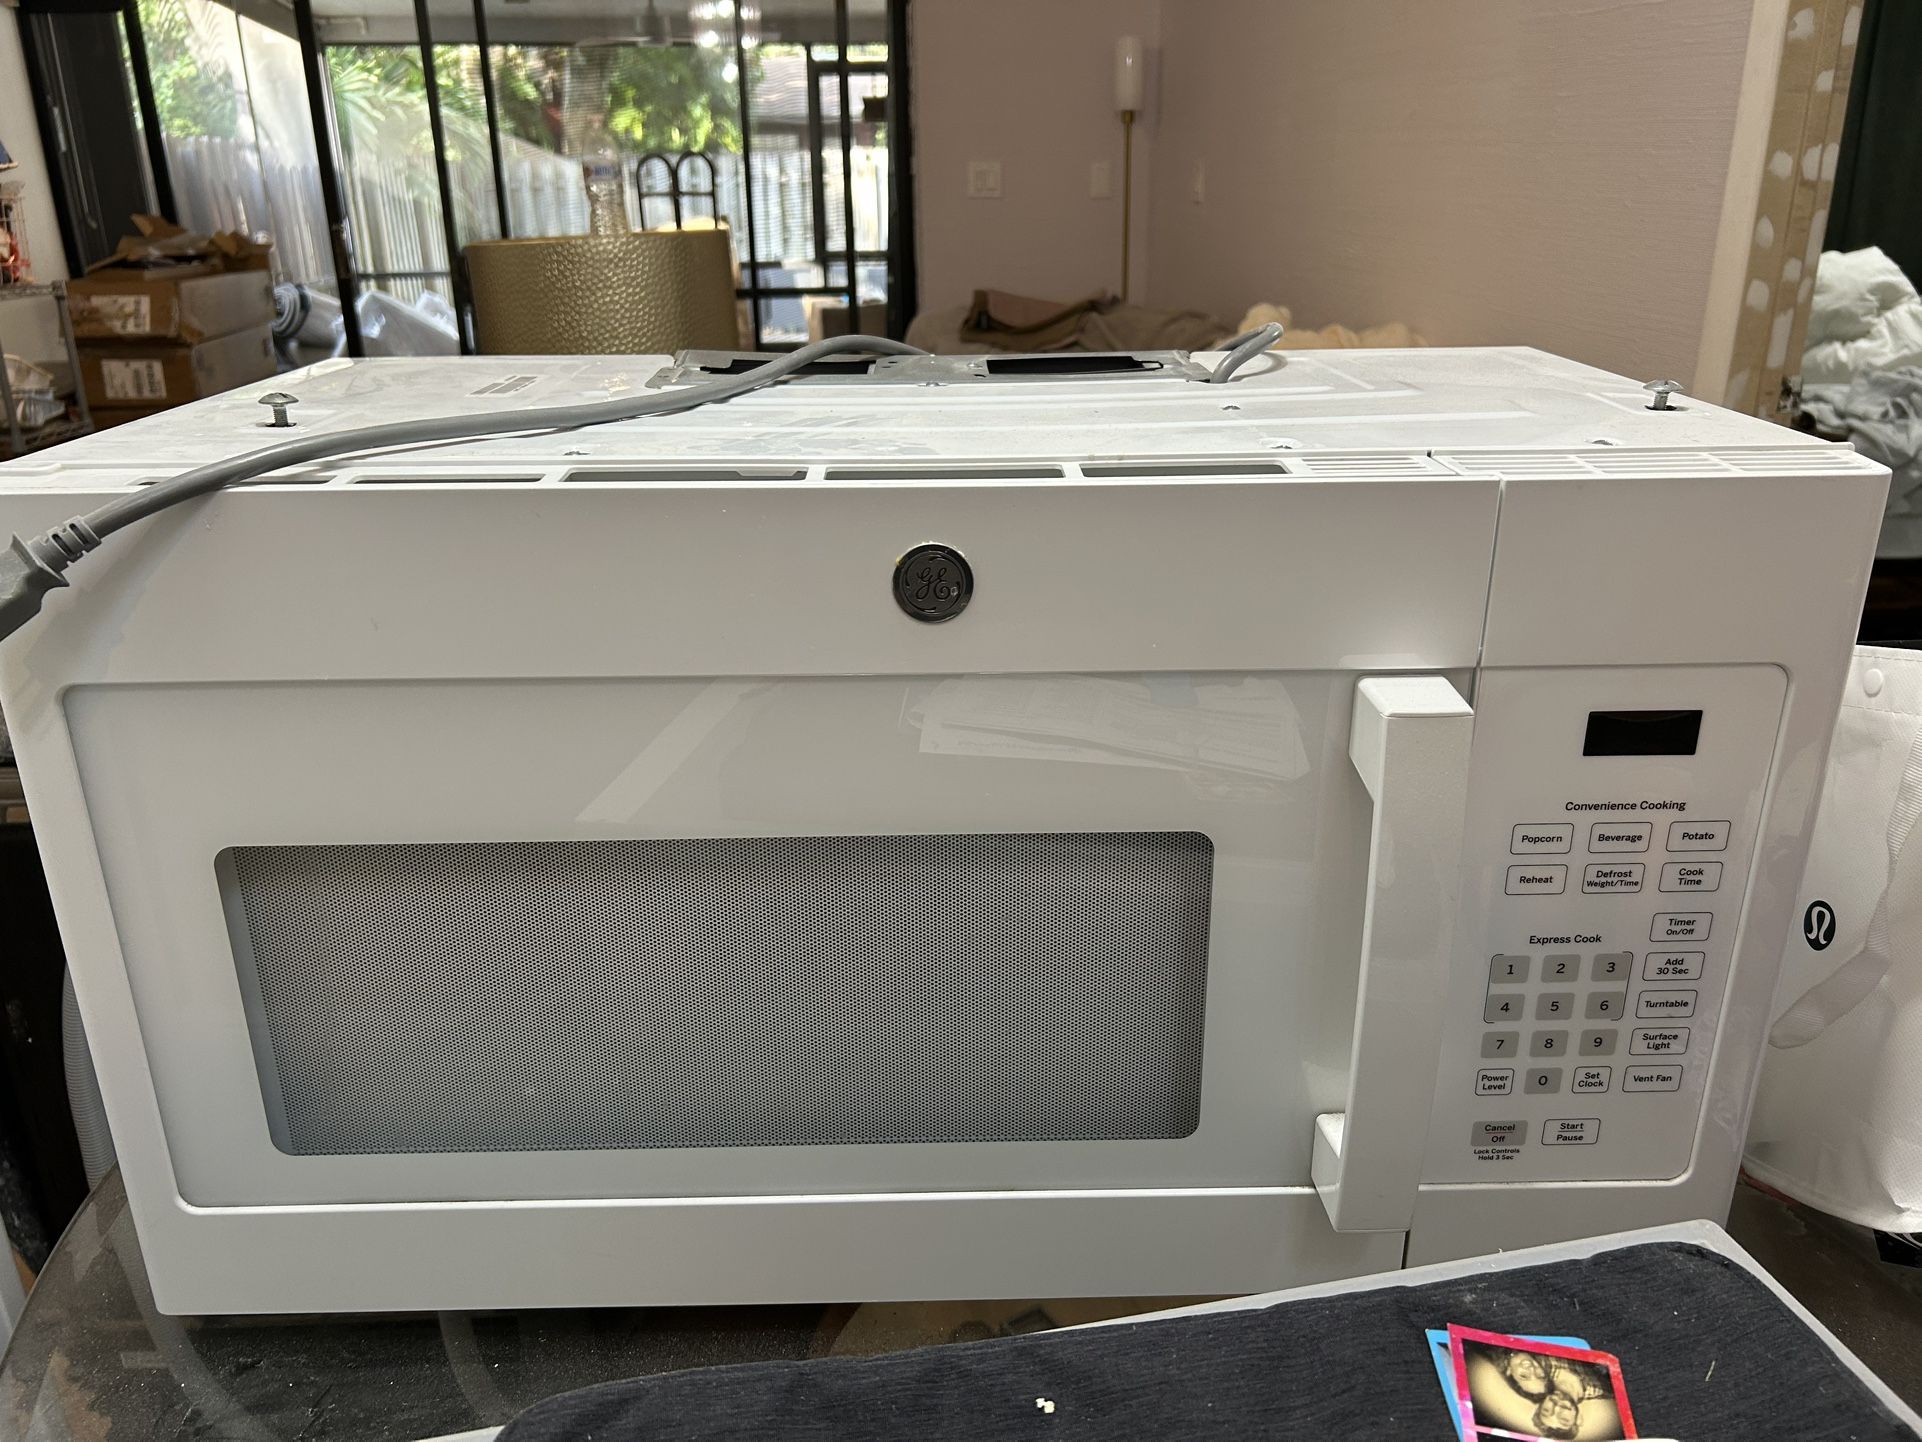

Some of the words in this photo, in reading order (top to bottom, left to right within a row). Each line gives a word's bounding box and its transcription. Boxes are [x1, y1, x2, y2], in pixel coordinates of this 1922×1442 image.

[1565, 801, 1637, 811] Convenience
[1639, 800, 1687, 812] Cooking
[1521, 834, 1563, 844] Popcorn
[1597, 834, 1643, 843] Beverage
[1681, 831, 1715, 840] Potato
[1596, 870, 1633, 878] Defrost
[1678, 867, 1704, 876] Cook
[1519, 875, 1553, 884] Reheat
[1586, 879, 1639, 888] Weight/Time
[1678, 878, 1702, 886] Time
[1668, 918, 1696, 926] Timer
[1665, 928, 1695, 936] On/Off
[1529, 935, 1571, 945] Express
[1574, 934, 1602, 943] Cook
[1664, 958, 1684, 966] Add
[1507, 964, 1515, 975] 1
[1556, 963, 1566, 974] 2
[1606, 962, 1616, 973] 3
[1656, 967, 1670, 975] 30
[1671, 967, 1689, 975] Sec
[1500, 1002, 1510, 1013] 4
[1550, 1001, 1560, 1012] 5
[1600, 1000, 1609, 1011] 6
[1644, 1000, 1689, 1008] Turntable
[1642, 1033, 1679, 1041] Surface
[1496, 1039, 1505, 1050] 7
[1544, 1038, 1554, 1049] 8
[1593, 1037, 1603, 1048] 9
[1646, 1041, 1671, 1050] Light
[1481, 1074, 1509, 1082] Power
[1584, 1071, 1600, 1080] Set
[1633, 1074, 1653, 1083] Vent
[1654, 1074, 1672, 1082] Fan
[1538, 1075, 1548, 1086] 0
[1577, 1079, 1604, 1088] Clock
[1482, 1082, 1506, 1091] Level
[1484, 1124, 1516, 1132] Cancel
[1559, 1122, 1584, 1131] Start
[1491, 1134, 1505, 1143] Off
[1556, 1133, 1584, 1142] Pause
